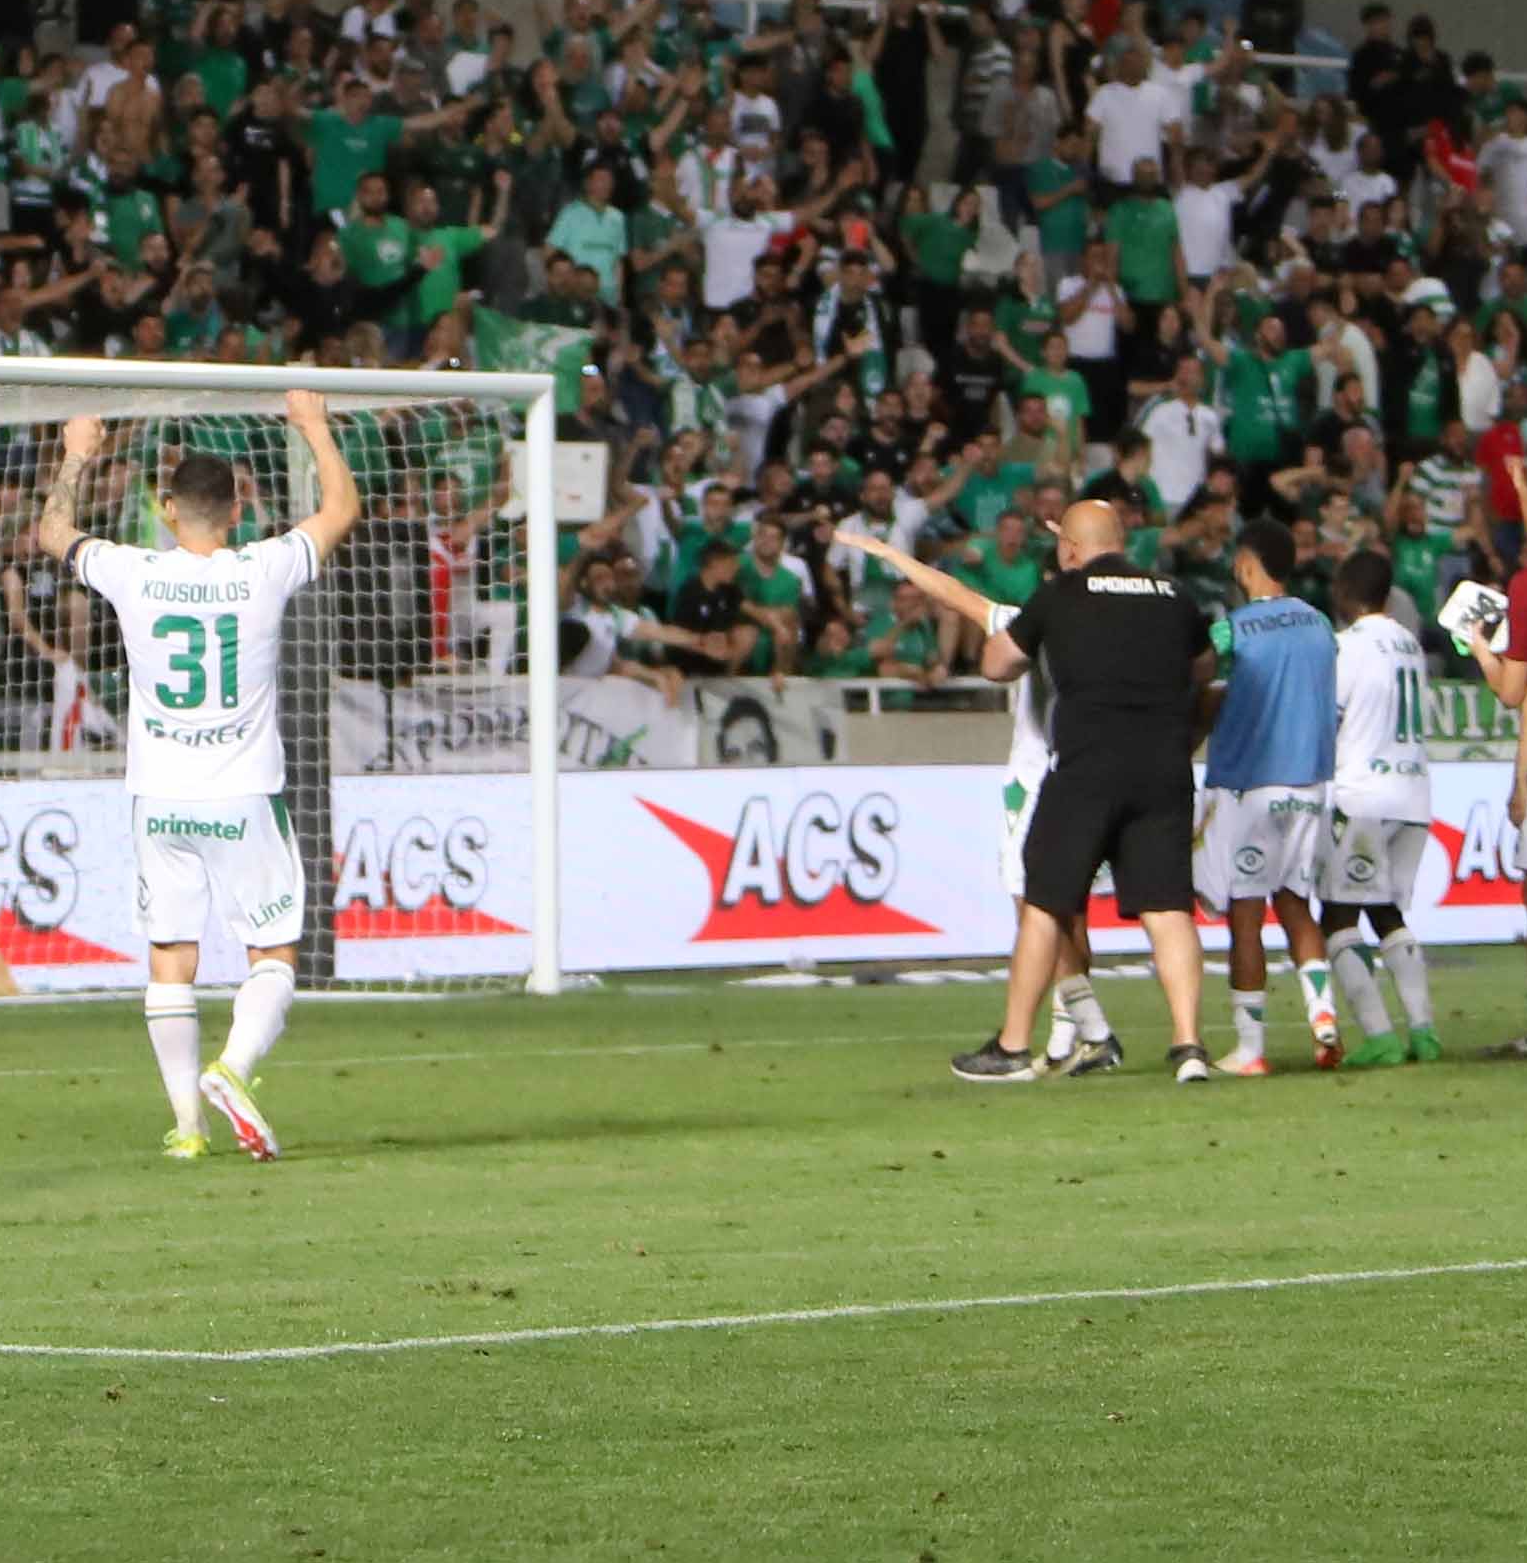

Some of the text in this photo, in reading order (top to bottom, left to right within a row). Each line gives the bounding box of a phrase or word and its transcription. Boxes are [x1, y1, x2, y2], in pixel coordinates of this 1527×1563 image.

[142, 579, 251, 604] KOUSOULOS
[151, 612, 239, 709] 31
[1396, 666, 1423, 744] 11
[147, 812, 247, 842] primetel
[335, 815, 489, 912] ACS
[719, 790, 899, 906] ACS
[1452, 798, 1521, 883] AC
[250, 893, 293, 930] Line
